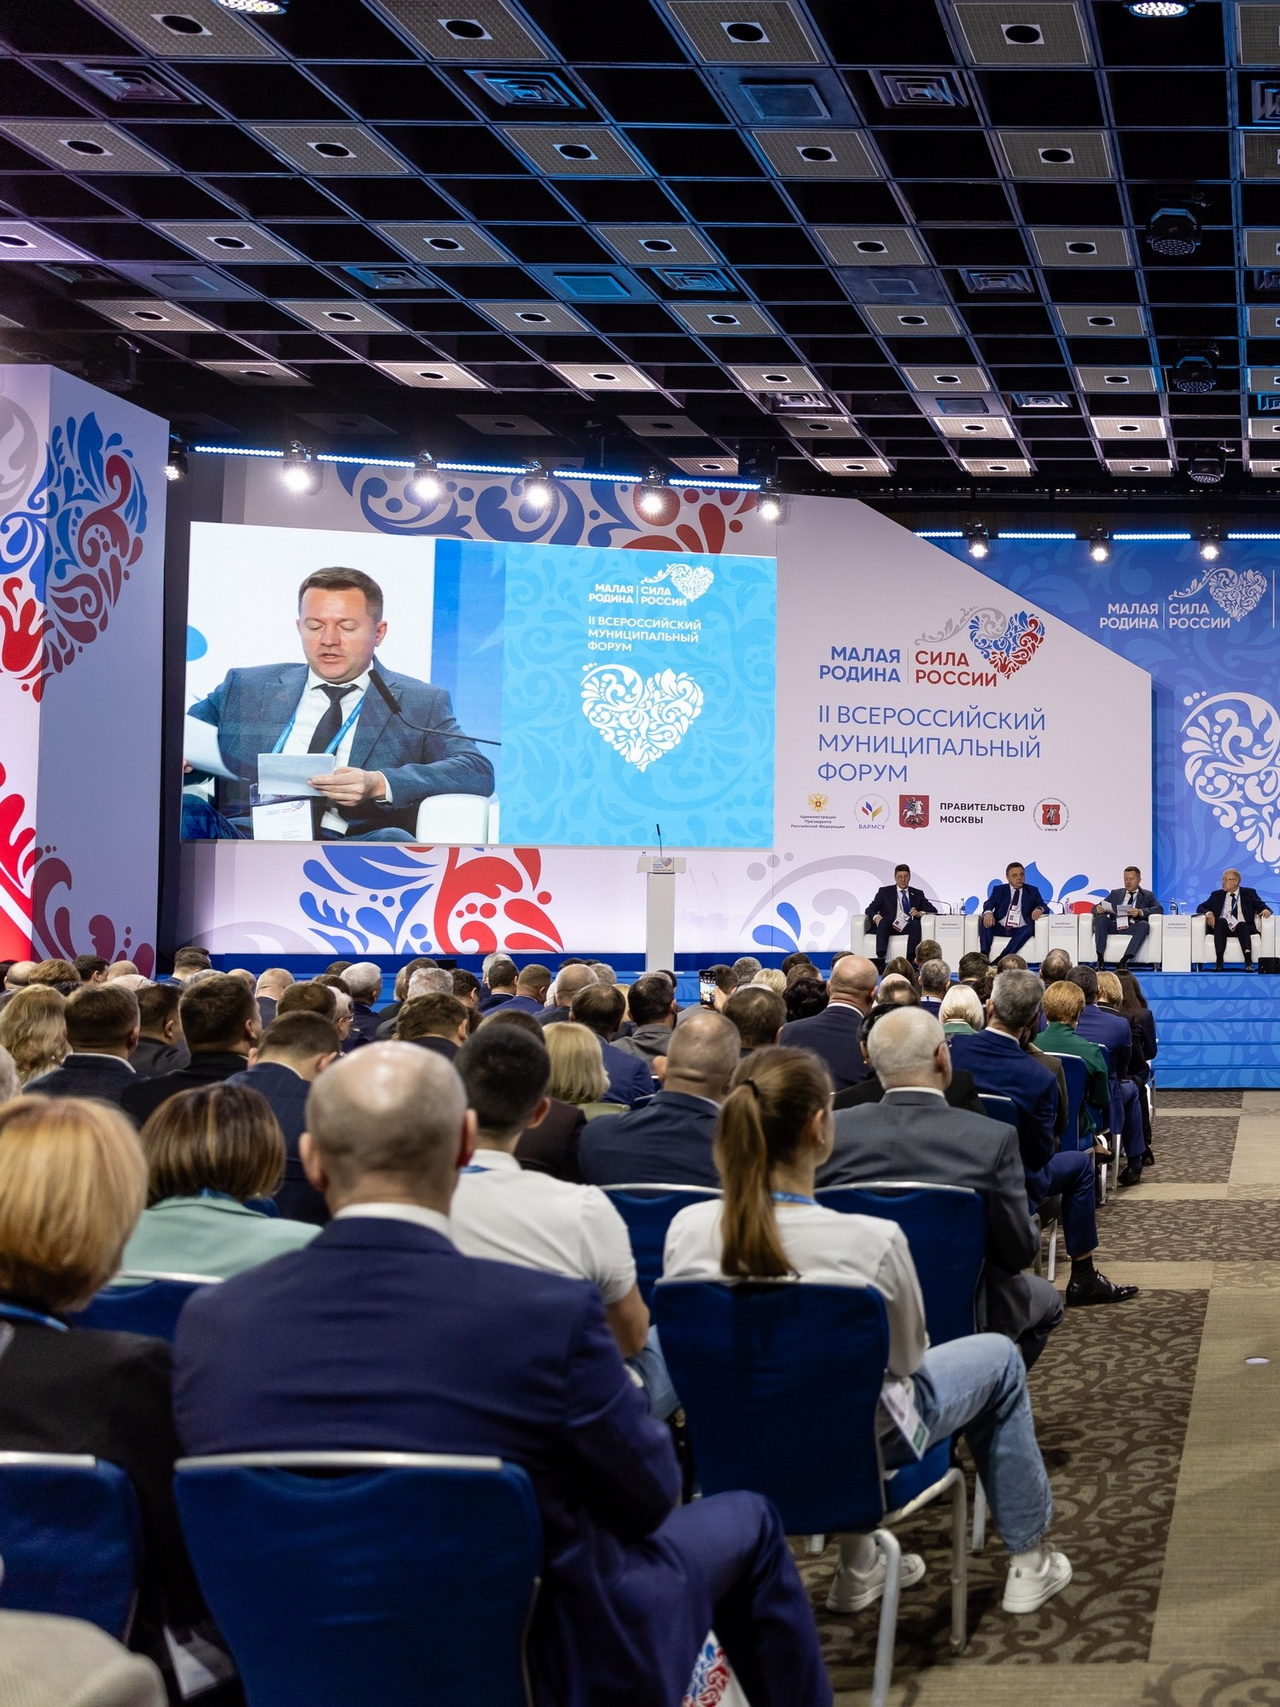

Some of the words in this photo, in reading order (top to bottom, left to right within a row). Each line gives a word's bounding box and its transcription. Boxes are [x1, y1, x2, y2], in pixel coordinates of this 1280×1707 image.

[595, 583, 634, 594] МАЛАЯ
[640, 585, 672, 596] СИЛА
[588, 593, 634, 604] РОДИНА
[640, 596, 687, 607] РОССИИ
[1107, 603, 1159, 615] МАЛАЯ
[1168, 603, 1210, 615] СИЛА
[588, 616, 595, 625] II
[598, 616, 702, 631] ВСЕРОССИЙСКИЙ
[1099, 617, 1159, 630] РОДИНА
[1169, 617, 1231, 629] РОССИИ
[588, 628, 699, 643] МУНИЦИПАЛЬНЫЙ
[587, 641, 632, 652] ФОРУМ
[830, 646, 901, 664] МАЛАЯ
[914, 650, 970, 667] СИЛА
[819, 665, 901, 683] РОДИНА
[915, 669, 998, 687] РОССИИ
[818, 705, 830, 723] II
[837, 704, 1046, 731] ВСЕРОССИЙСКИЙ
[818, 733, 1041, 759] МУНИЦИПАЛЬНЫЙ
[817, 762, 908, 782] ФОРУМ
[940, 802, 1025, 812] ПРАВИТЕЛЬСТВО
[940, 815, 984, 824] МОСКВЫ
